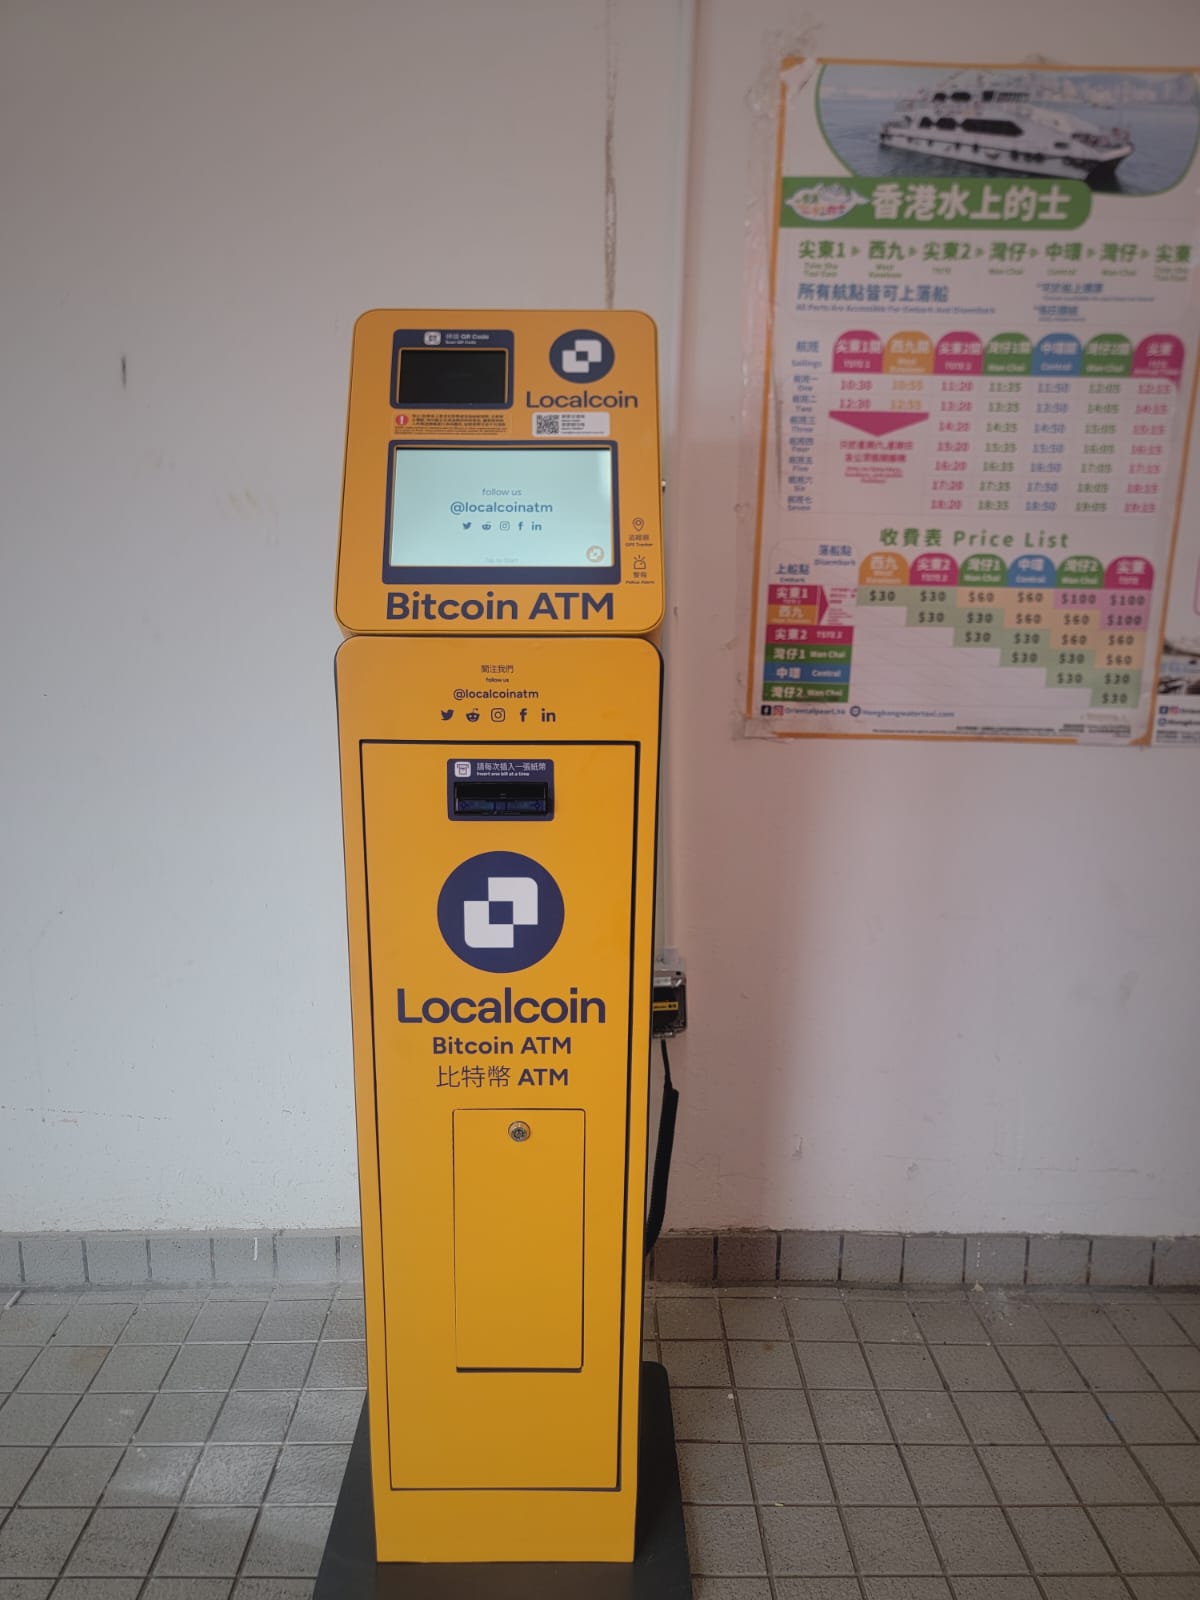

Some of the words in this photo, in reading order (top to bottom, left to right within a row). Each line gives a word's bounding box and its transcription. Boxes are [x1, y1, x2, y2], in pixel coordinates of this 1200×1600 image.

[871, 183, 1070, 221] 香港水上的士
[868, 240, 904, 260] 西九
[990, 242, 1027, 262] 灣仔
[1045, 242, 1082, 261] 中環
[1101, 242, 1138, 262] 灣仔
[526, 391, 638, 408] Localcoin
[482, 488, 509, 496] follow
[450, 502, 553, 515] @localcoinatm
[880, 528, 942, 546] 收費表
[954, 530, 1014, 548] Price
[1024, 532, 1069, 548] List
[917, 558, 950, 571] 尖東2
[870, 590, 896, 601] $30
[920, 590, 946, 602] $30
[968, 592, 994, 602] $60
[1018, 592, 1043, 602] $60
[1061, 594, 1096, 604] $100
[1110, 594, 1146, 606] $100
[386, 591, 518, 620] Bitcoin
[528, 592, 614, 620] ATM
[918, 612, 944, 623] $30
[967, 612, 992, 623] $30
[1016, 614, 1042, 624] $60
[1064, 614, 1090, 625] $60
[1107, 614, 1142, 626] $100
[774, 628, 808, 641] 尖東2
[966, 632, 991, 642] $30
[1014, 634, 1040, 644] $30
[1061, 634, 1087, 645] $60
[1108, 635, 1134, 646] $60
[774, 648, 805, 660] 灣仔1
[1012, 652, 1038, 663] $30
[1059, 654, 1084, 664] $30
[1106, 655, 1132, 666] $60
[776, 667, 800, 678] 中環
[1057, 673, 1083, 684] $30
[1104, 674, 1130, 684] $30
[453, 688, 538, 700] @localcoinatm
[771, 686, 803, 698] 灣仔2
[1102, 693, 1128, 704] $30
[476, 762, 546, 771] 請每次插入一張紙幣
[397, 987, 606, 1024] Localcoin
[433, 1036, 513, 1054] Bitcoin
[520, 1037, 572, 1054] ATM
[436, 1065, 511, 1088] 比特幣
[518, 1068, 568, 1086] ATM
